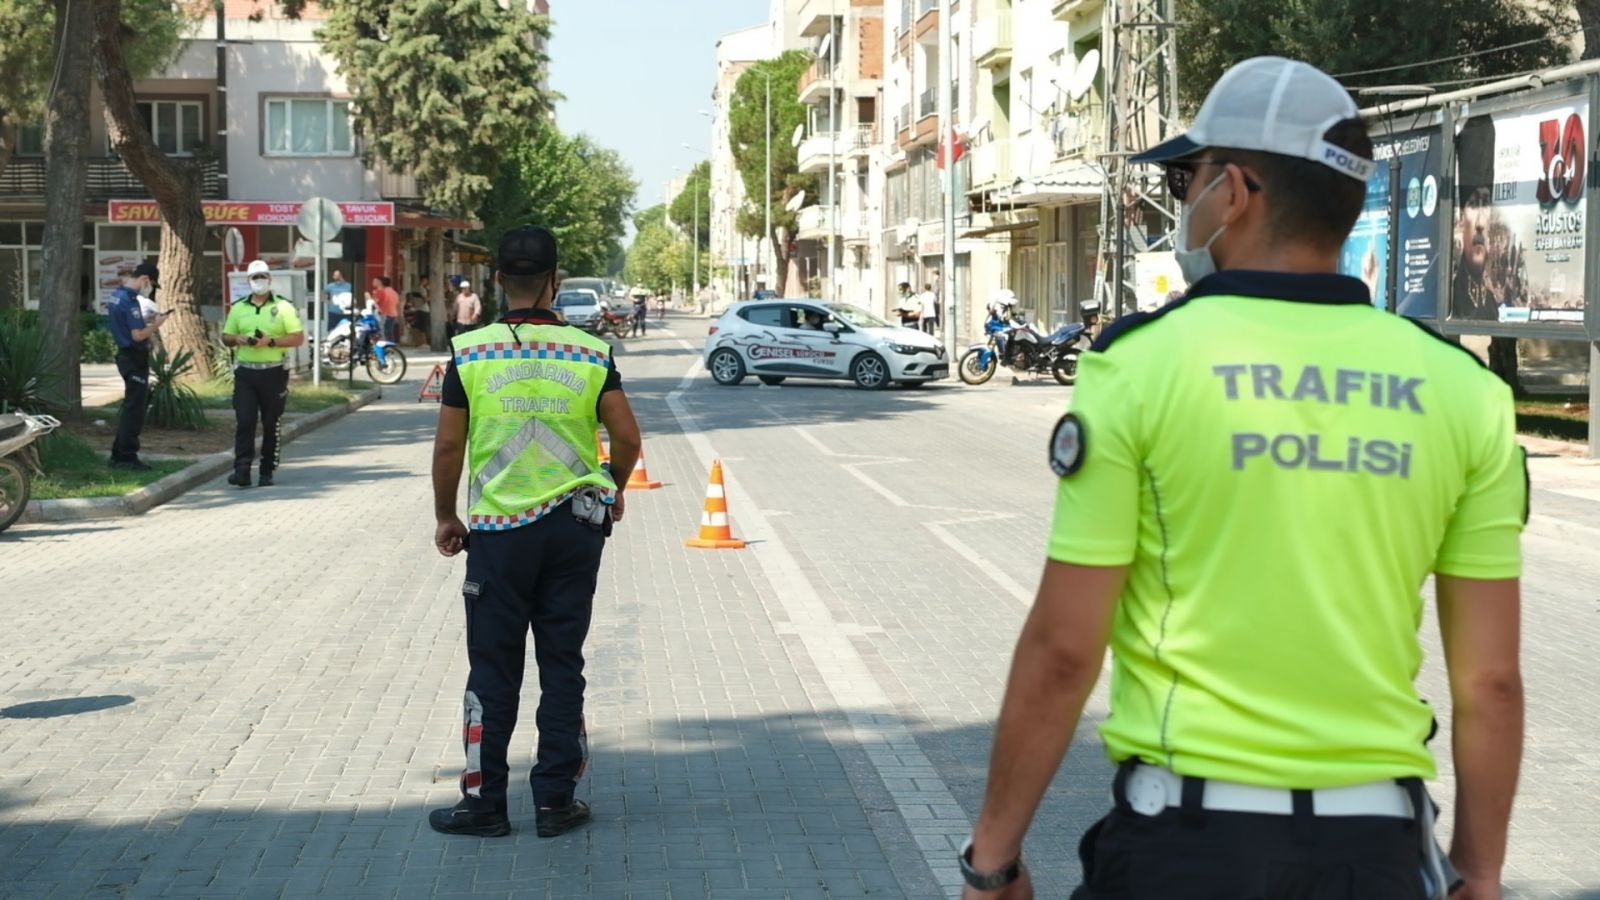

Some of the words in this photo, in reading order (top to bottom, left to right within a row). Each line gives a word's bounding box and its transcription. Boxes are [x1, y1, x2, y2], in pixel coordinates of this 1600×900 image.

[268, 204, 295, 213] TOST
[345, 205, 377, 214] TAVUK
[486, 361, 587, 397] JANDARMA
